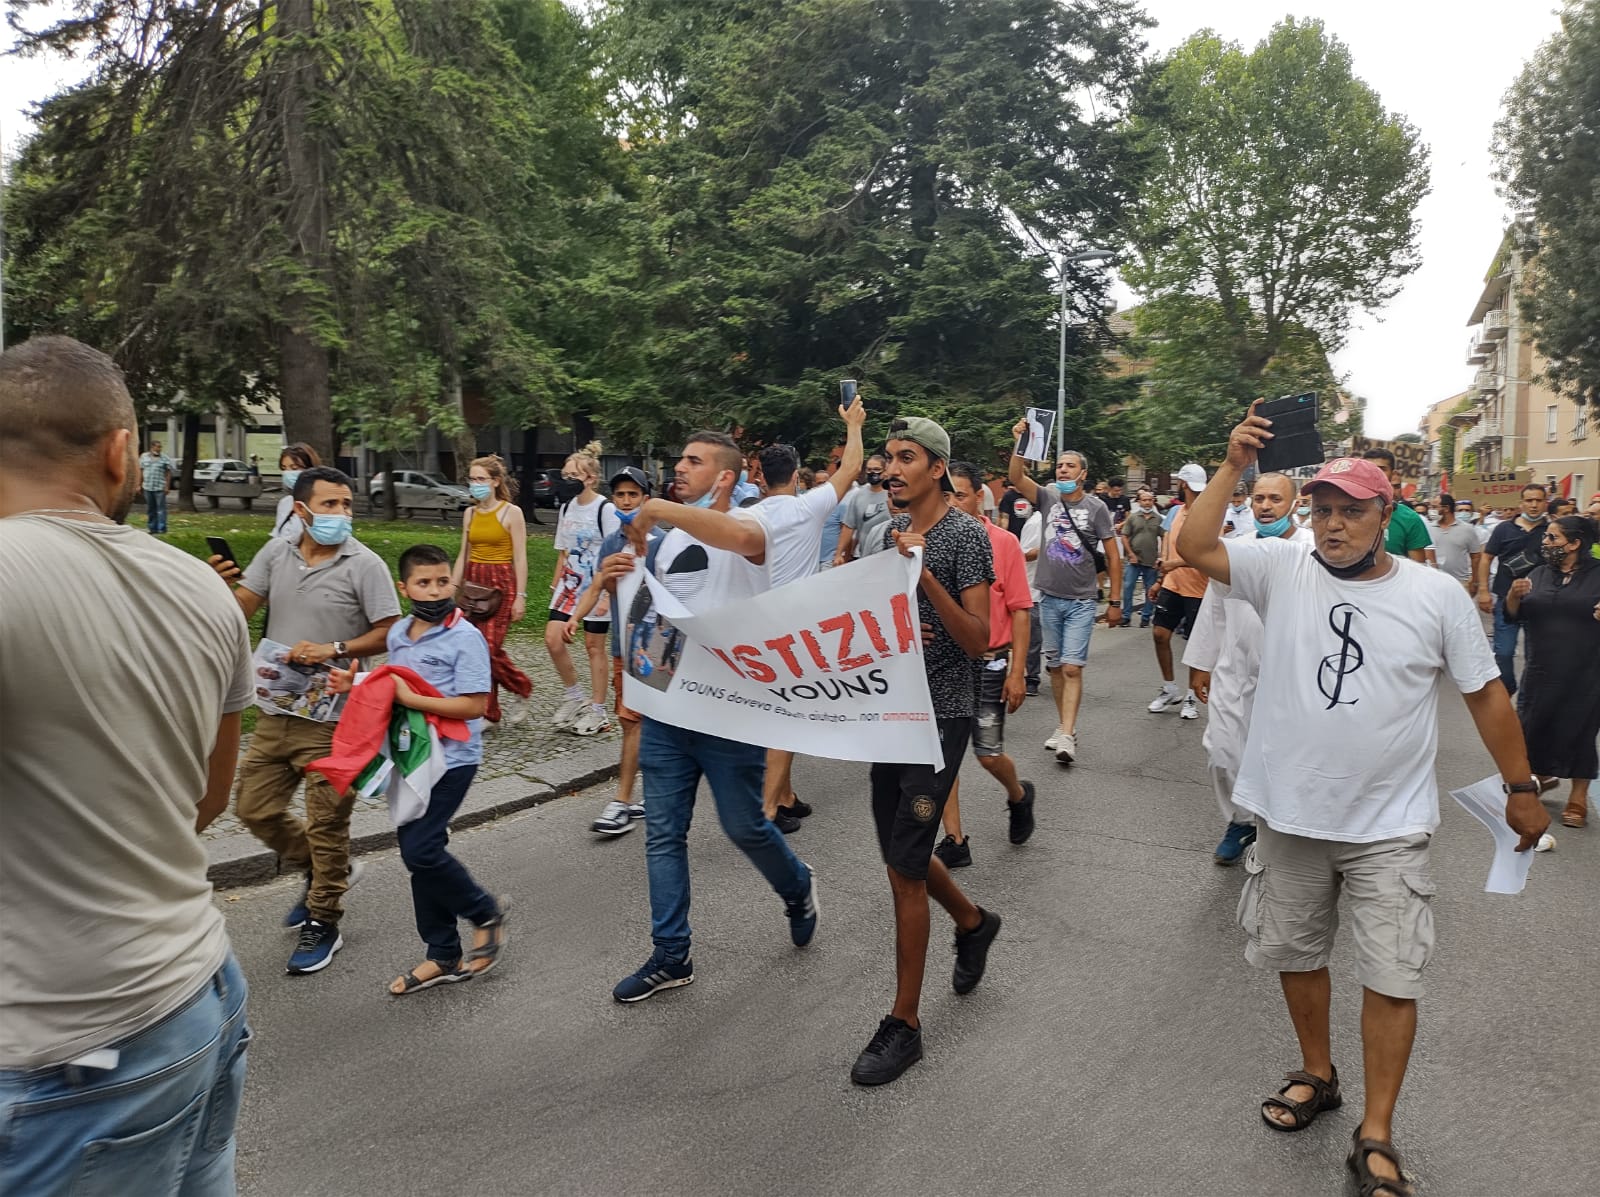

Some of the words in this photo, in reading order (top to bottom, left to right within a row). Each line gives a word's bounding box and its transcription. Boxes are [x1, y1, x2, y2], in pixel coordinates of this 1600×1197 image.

[679, 679, 726, 699] YOUNS
[727, 691, 772, 711] doveva
[768, 668, 888, 702] YOUNS
